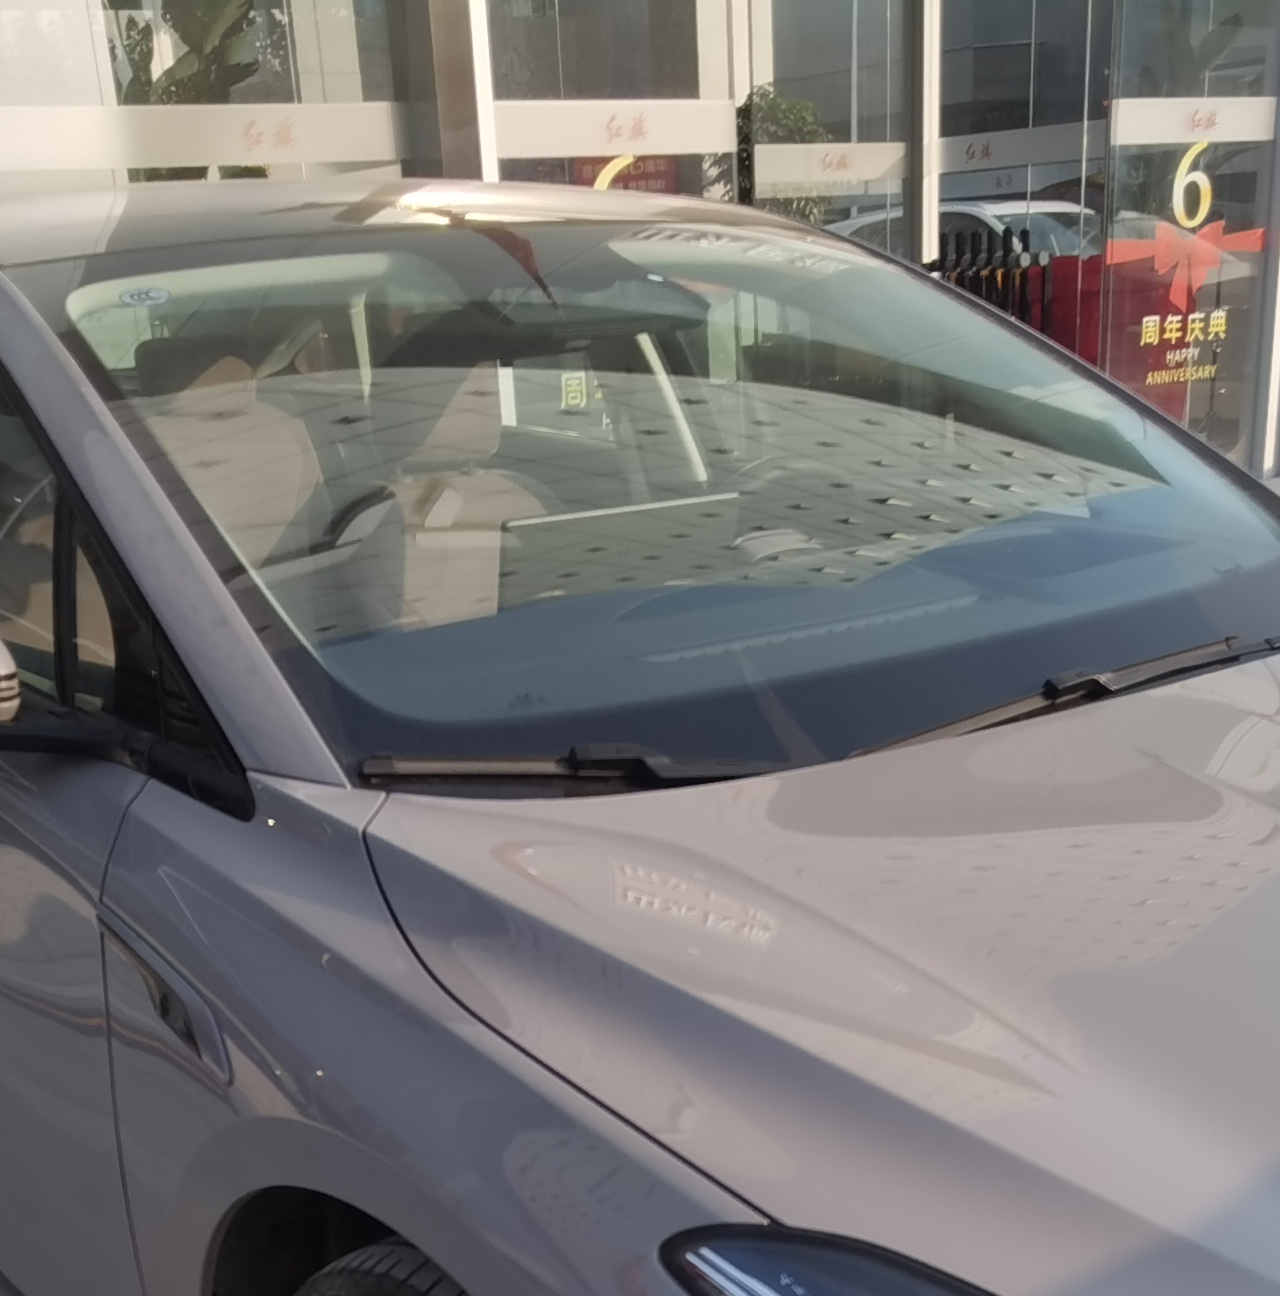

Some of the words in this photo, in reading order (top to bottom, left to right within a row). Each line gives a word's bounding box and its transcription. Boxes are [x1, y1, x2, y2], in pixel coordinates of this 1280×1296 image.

[605, 112, 648, 145] 红旗
[965, 139, 992, 164] 红旗
[1172, 141, 1210, 229] 6
[1140, 309, 1228, 347] 周年庆典
[1166, 346, 1201, 365] HAPPY
[1145, 364, 1218, 387] ANNIVERSARY
